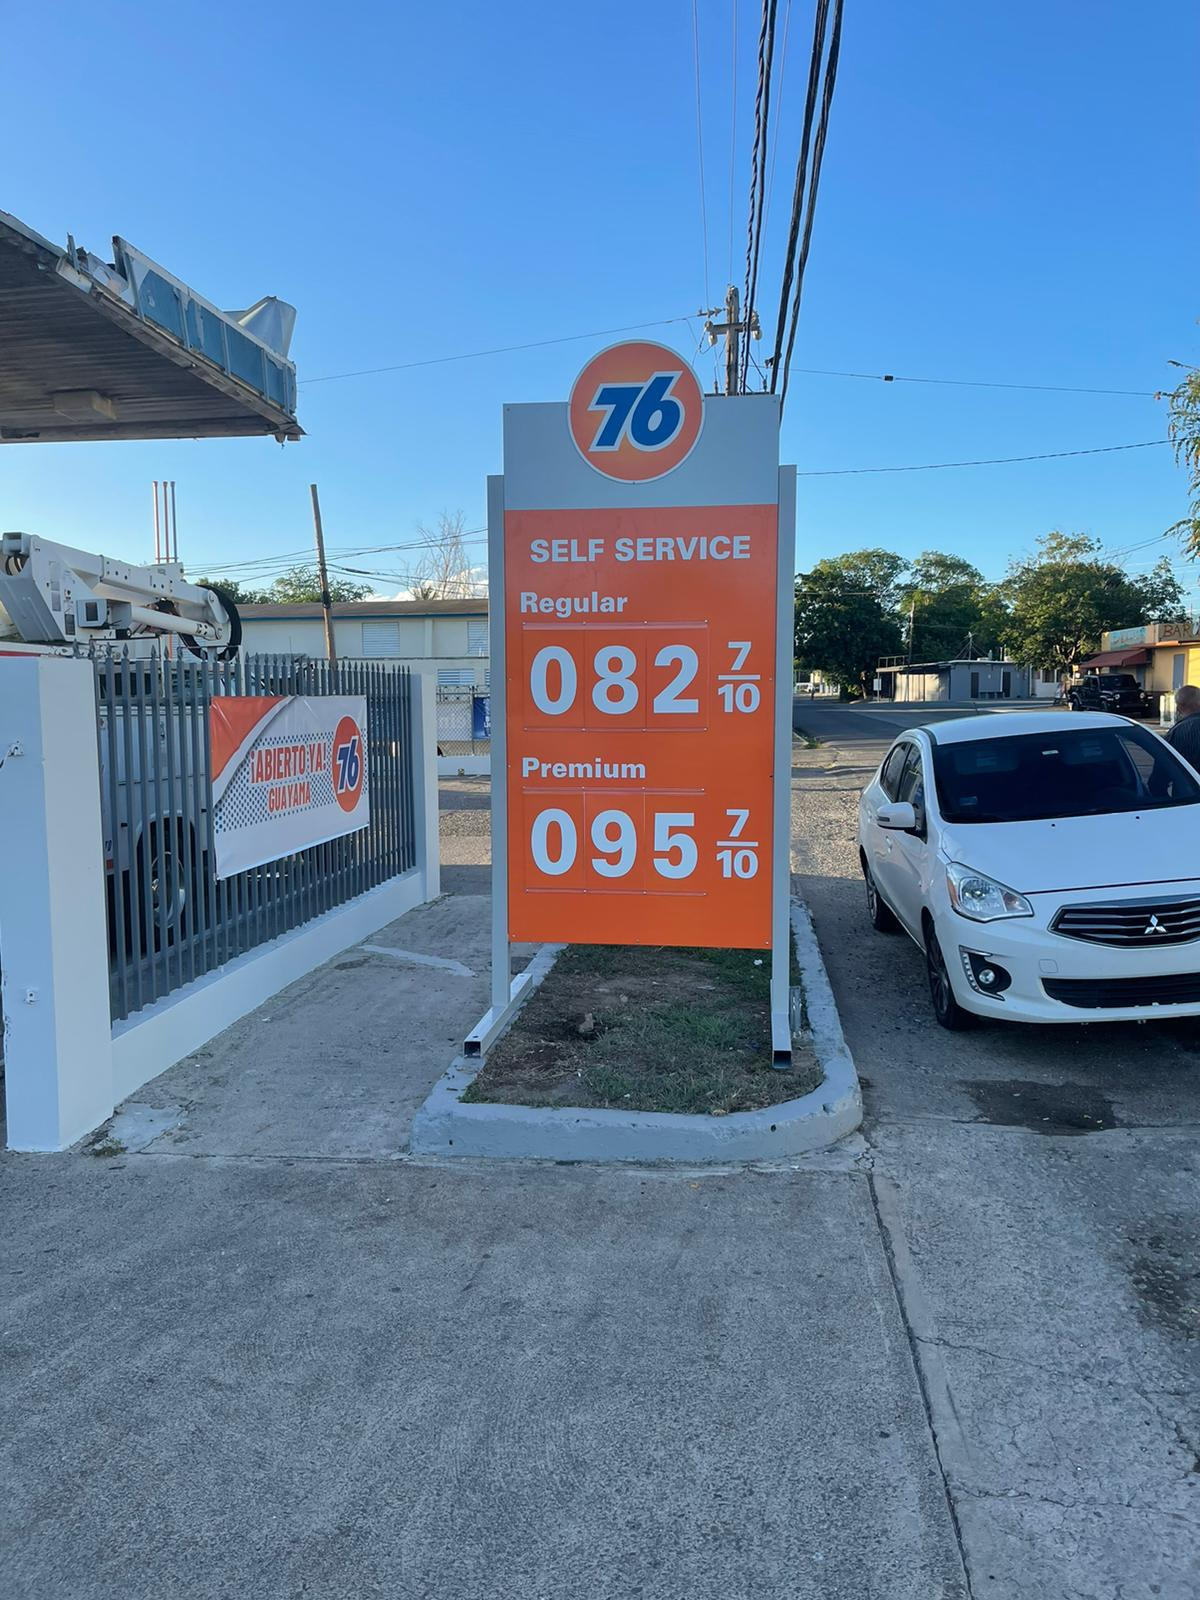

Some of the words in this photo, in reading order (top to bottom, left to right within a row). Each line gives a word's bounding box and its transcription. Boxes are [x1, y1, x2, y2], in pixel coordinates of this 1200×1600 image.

[587, 370, 685, 452] 76
[530, 538, 604, 563] SELF
[615, 535, 751, 562] SERVICE
[520, 591, 628, 618] Regular
[728, 641, 752, 671] 7
[530, 645, 699, 715] 082
[717, 683, 761, 713] 10
[310, 743, 327, 772] YA!
[337, 736, 360, 793] 76
[522, 757, 646, 779] Premium
[269, 783, 311, 812] GUAYAMA
[726, 809, 750, 838] 7
[530, 808, 698, 879] 095
[716, 850, 759, 879] 10
